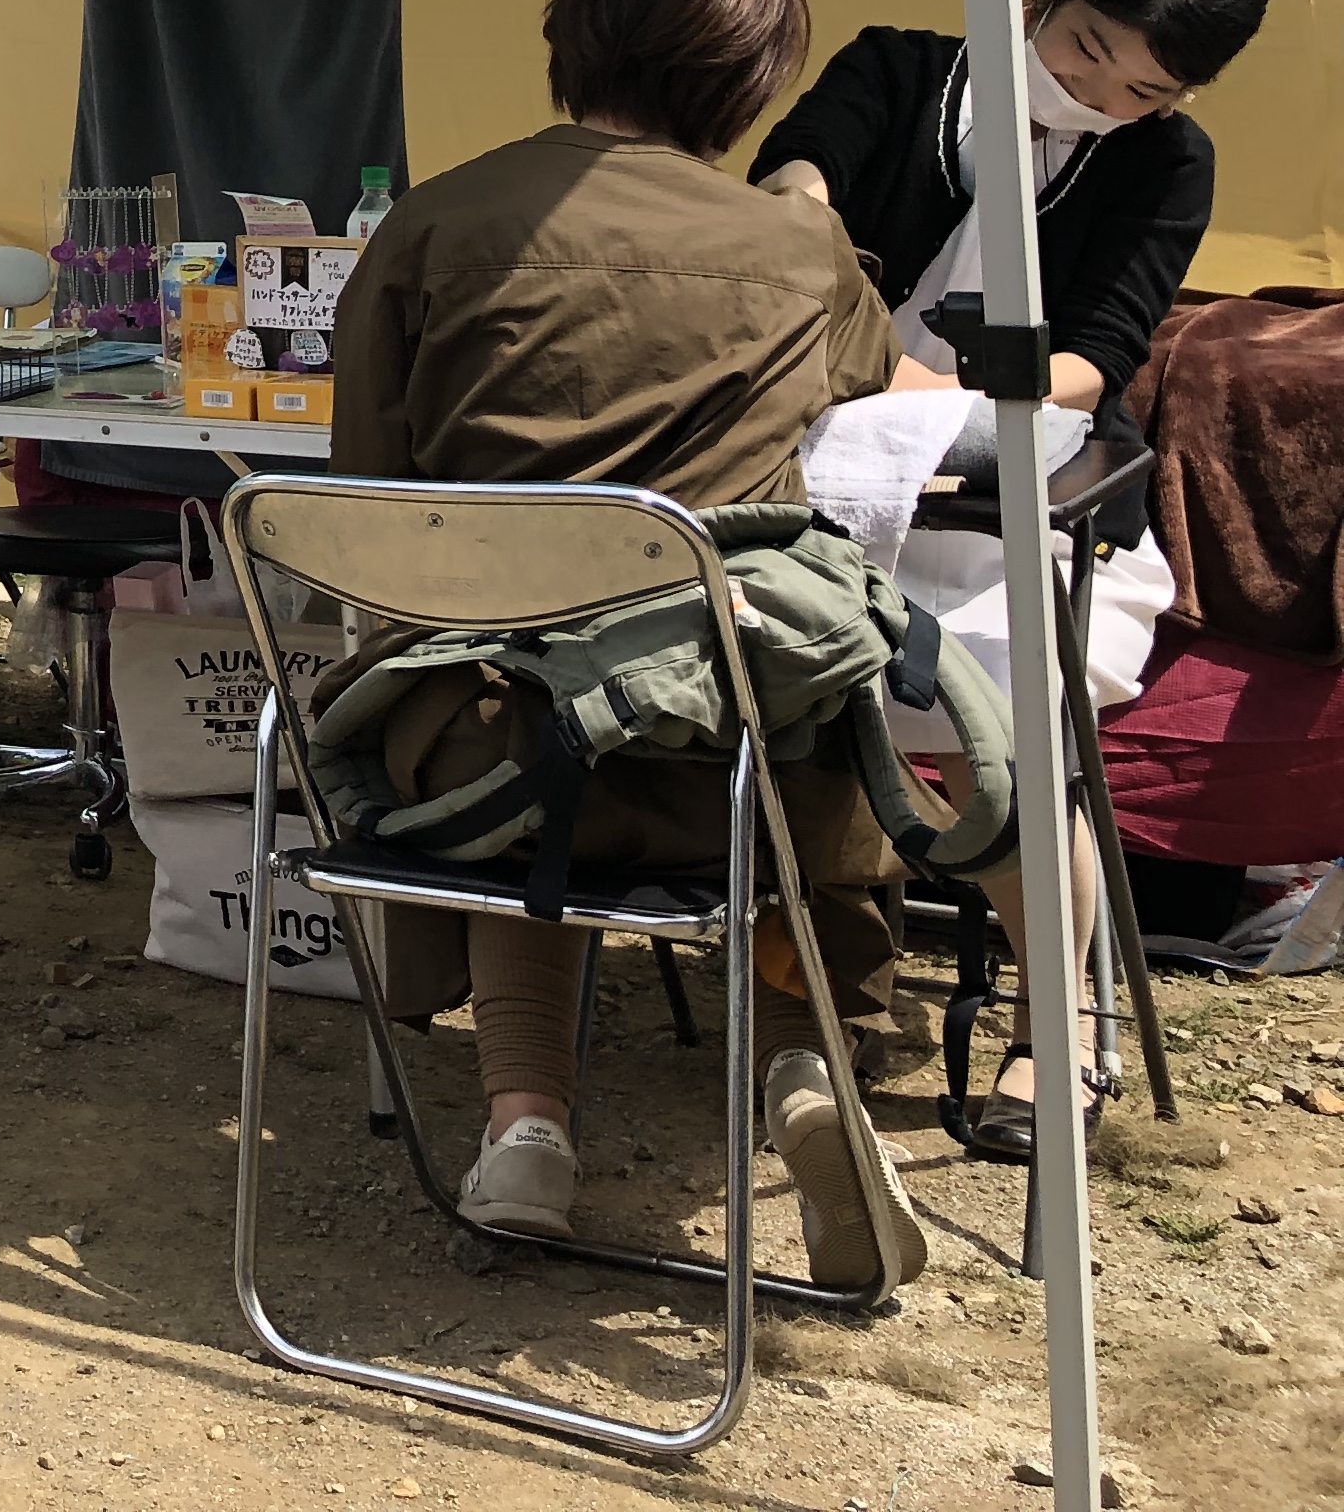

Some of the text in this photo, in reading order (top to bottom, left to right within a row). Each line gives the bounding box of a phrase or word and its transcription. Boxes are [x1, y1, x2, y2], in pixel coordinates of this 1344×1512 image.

[252, 289, 322, 302] ハンドマッサージ
[206, 733, 243, 747] OPEN
